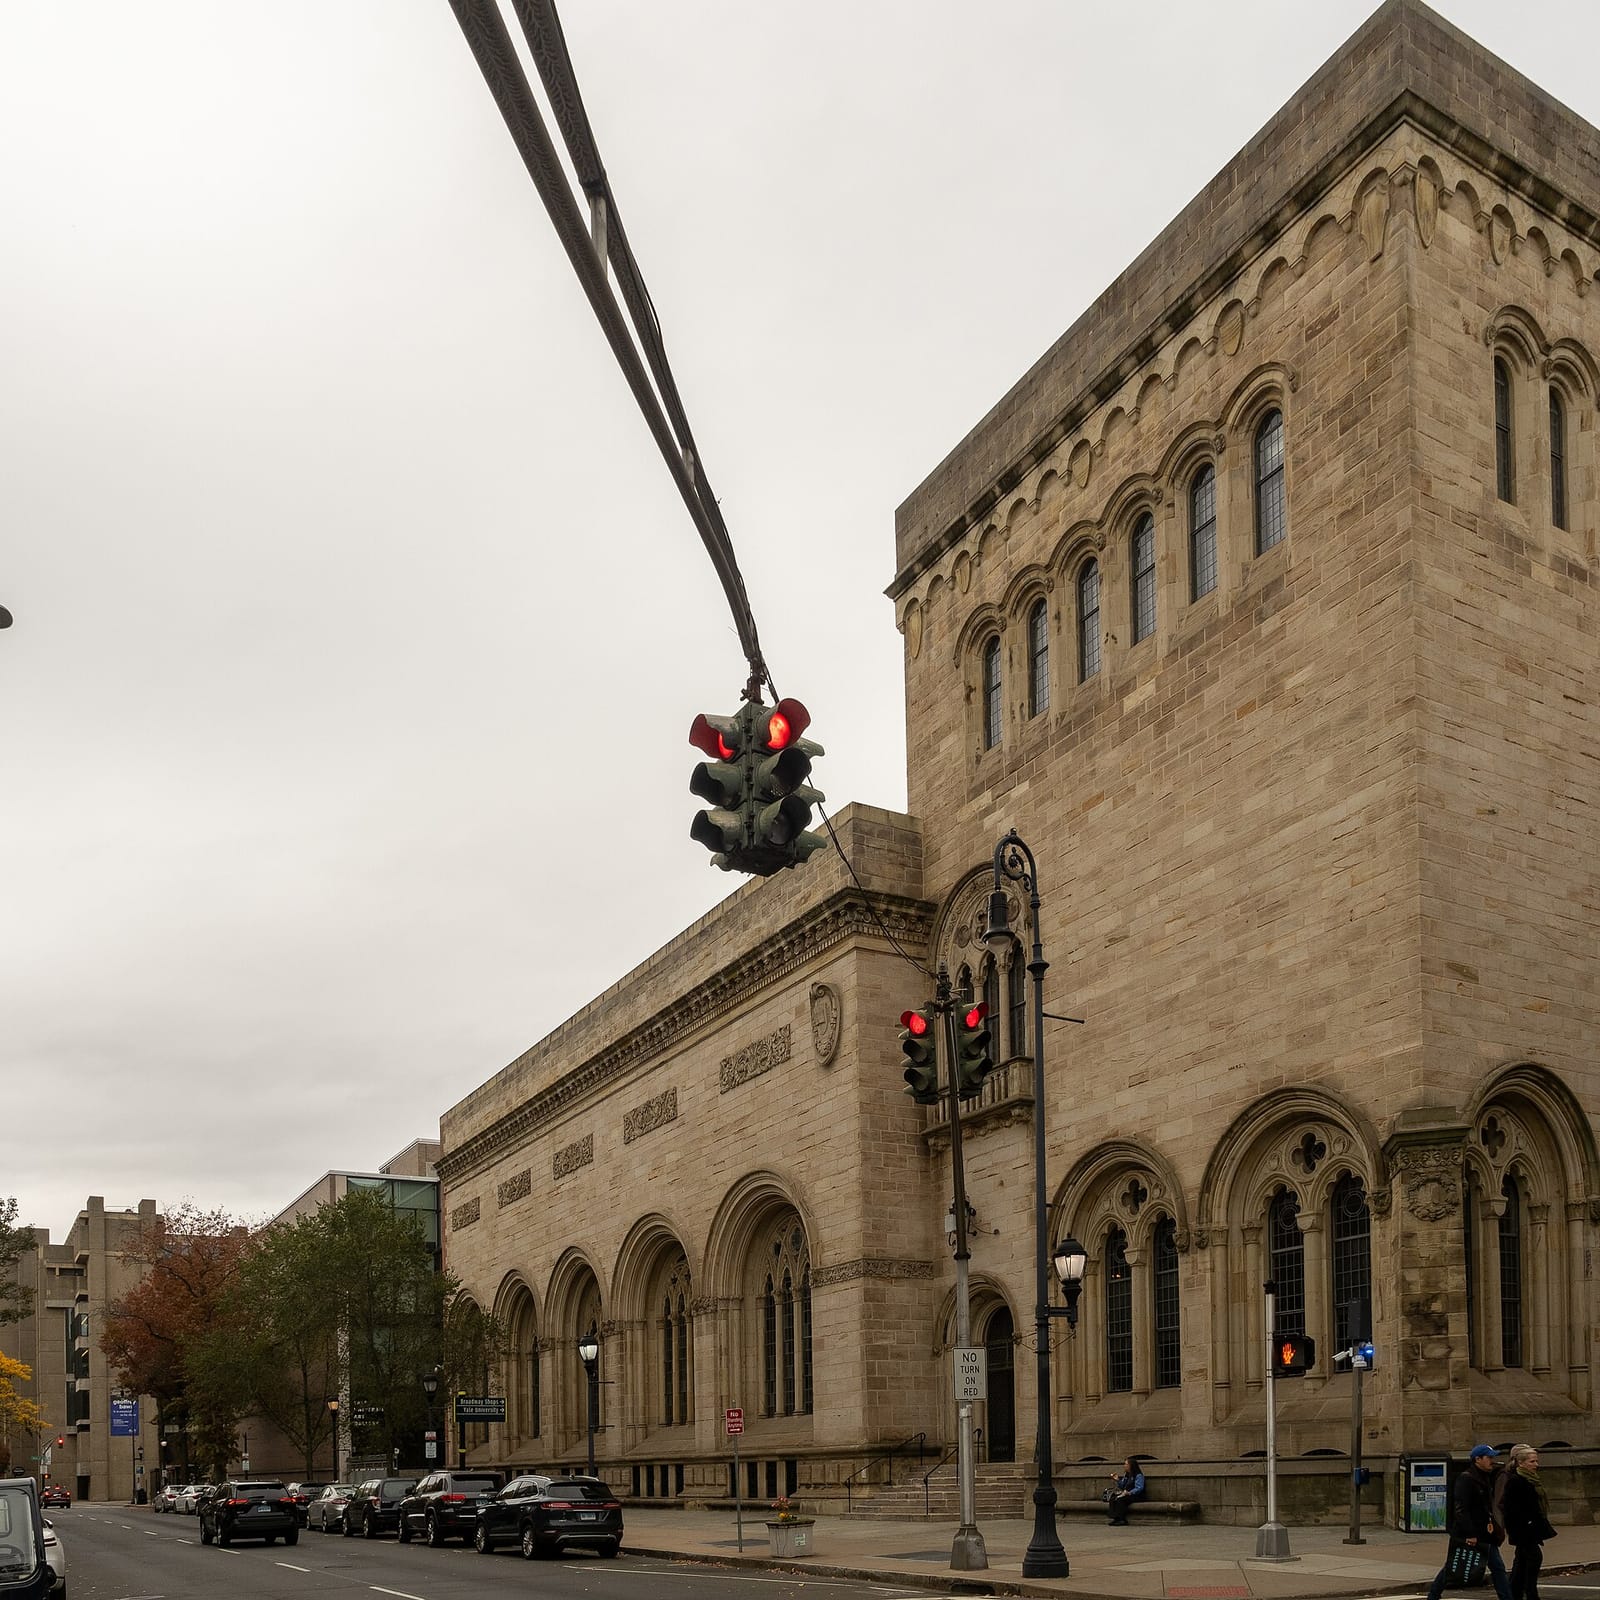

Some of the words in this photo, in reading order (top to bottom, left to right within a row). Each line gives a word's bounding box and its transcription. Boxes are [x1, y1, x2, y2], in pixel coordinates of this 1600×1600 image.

[962, 1352, 977, 1363] NO
[960, 1365, 980, 1374] TURN
[965, 1376, 976, 1385] ON
[963, 1387, 978, 1396] RED
